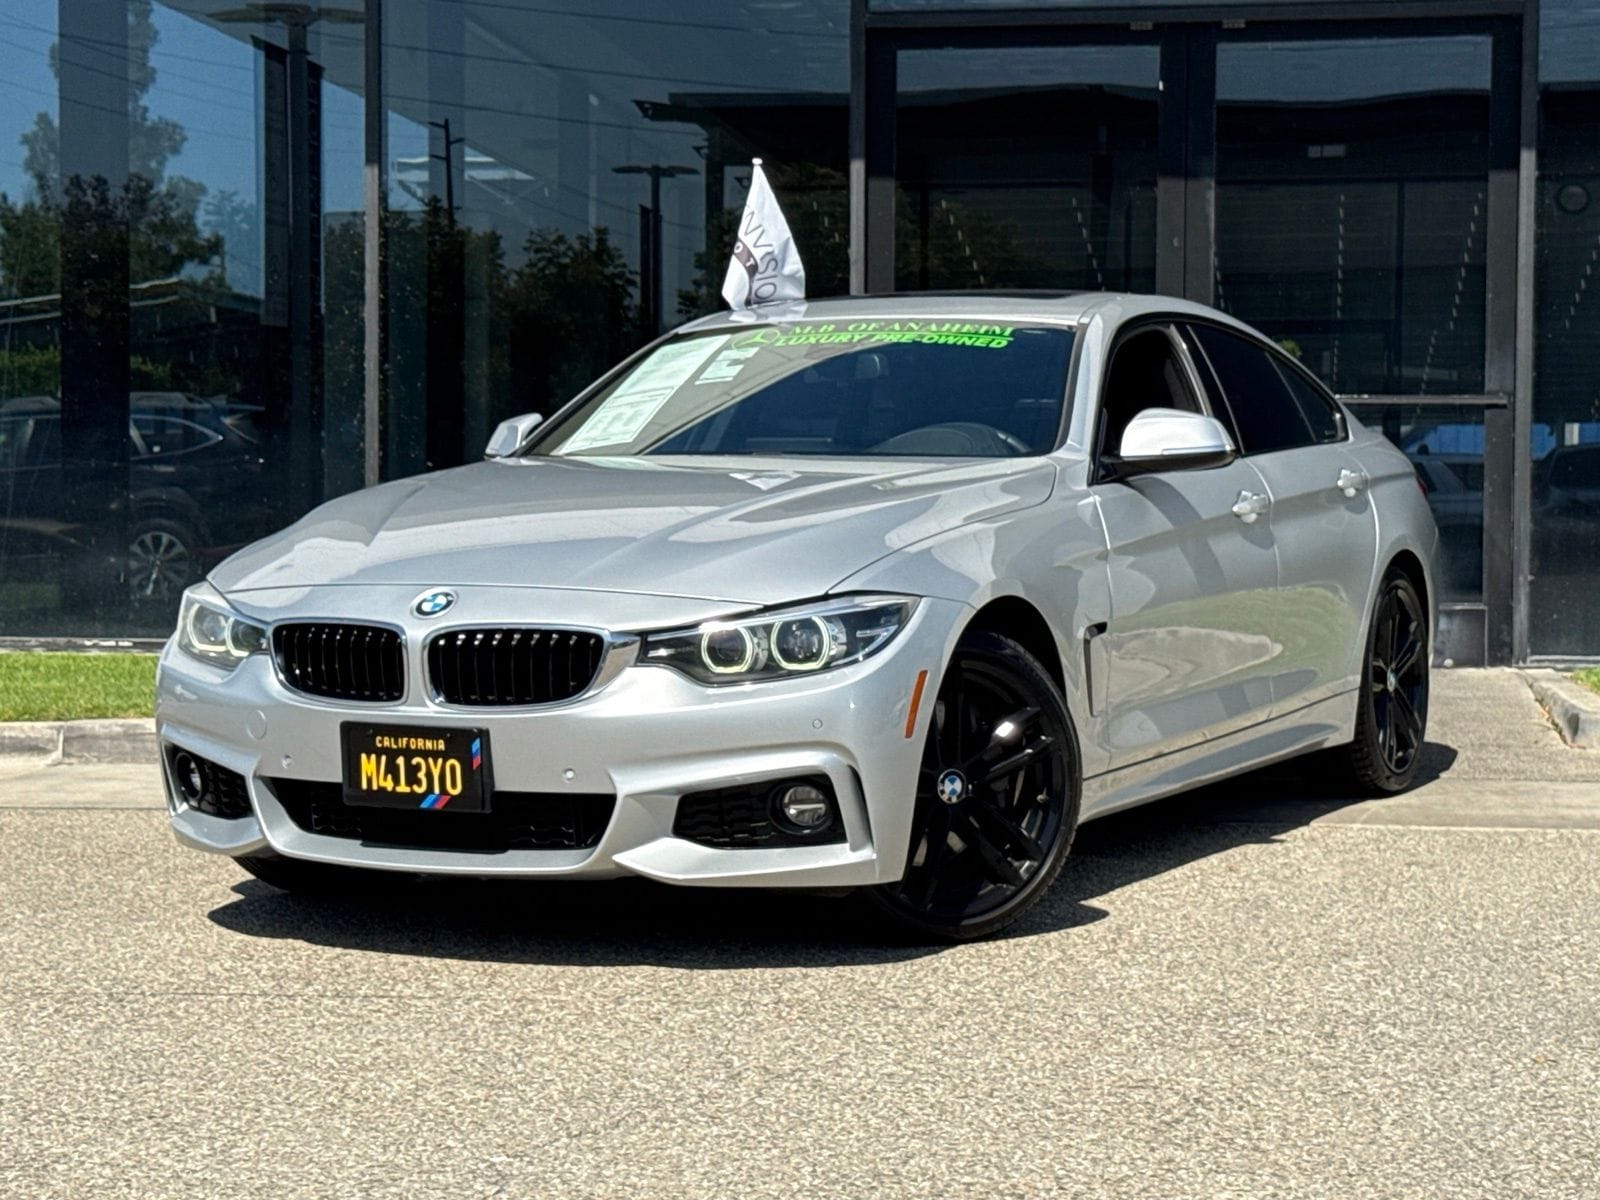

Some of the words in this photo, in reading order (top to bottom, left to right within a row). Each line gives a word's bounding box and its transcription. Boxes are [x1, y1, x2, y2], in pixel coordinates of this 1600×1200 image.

[774, 334, 868, 347] LUXURY
[869, 333, 1009, 348] PRE-OWNED
[375, 736, 445, 751] CALIFORNIA
